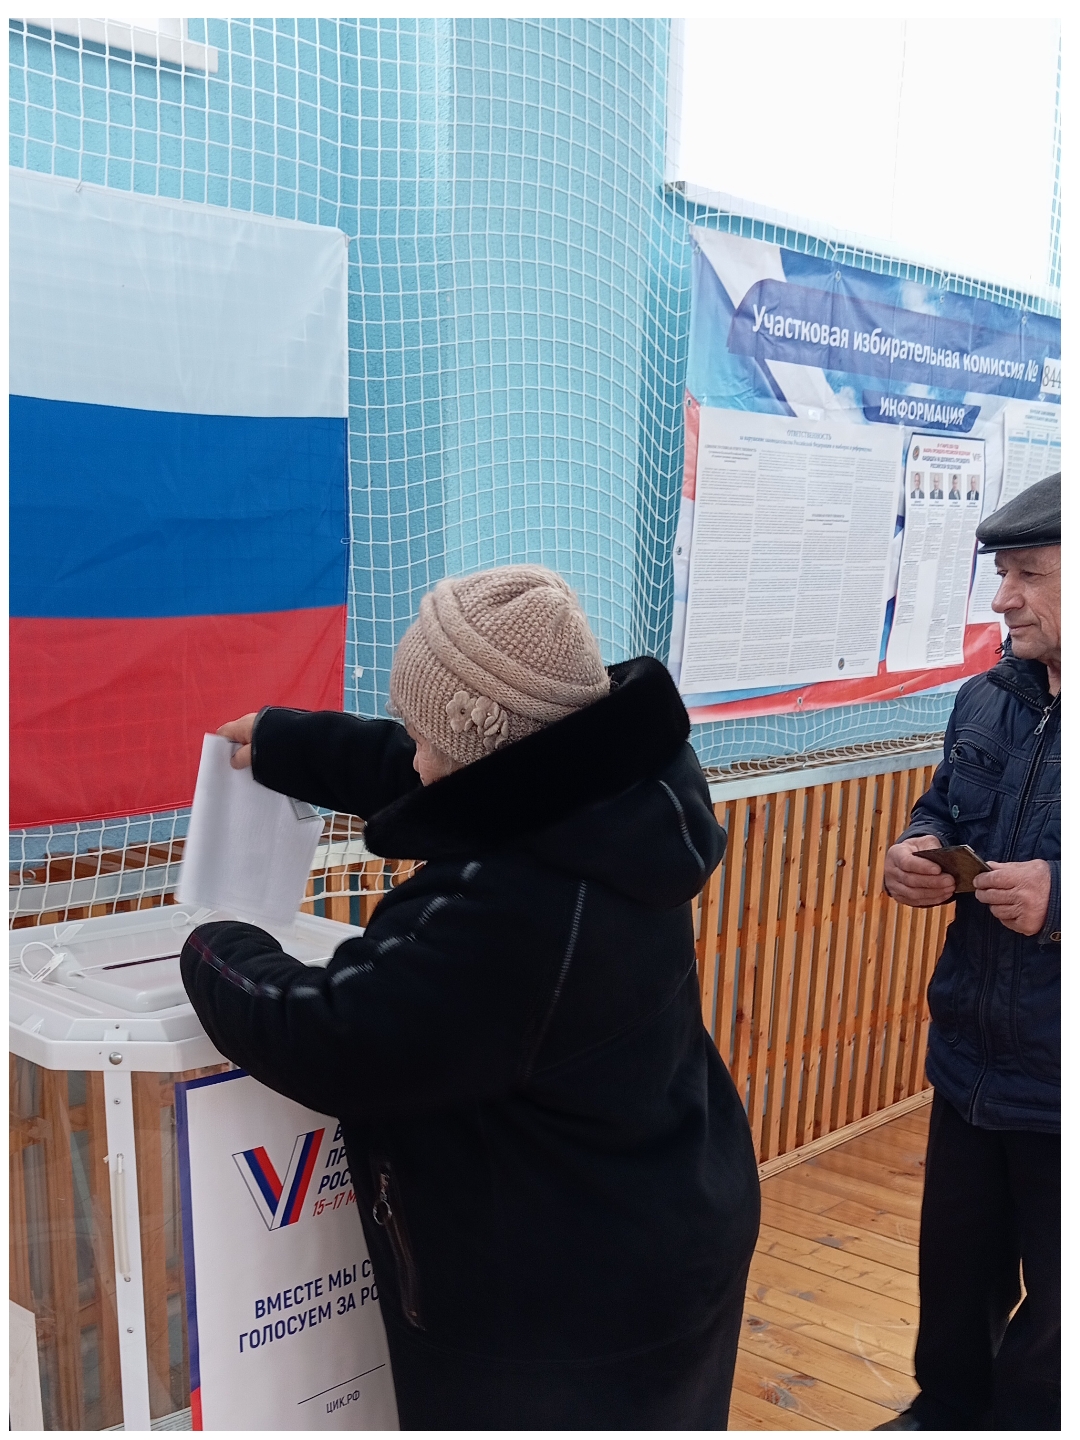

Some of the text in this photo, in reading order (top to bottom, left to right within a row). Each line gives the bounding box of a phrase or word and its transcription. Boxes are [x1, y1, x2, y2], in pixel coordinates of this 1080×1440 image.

[752, 304, 849, 349] Участковая
[853, 328, 961, 370] избирательная
[963, 353, 1025, 380] комиссия
[1025, 360, 1039, 382] №
[879, 397, 965, 428] ИНФОРМАЦИЯ
[318, 1167, 352, 1194] РОС
[255, 1277, 323, 1319] ВМЕСТЕ
[328, 1264, 357, 1291] МЫ
[239, 1301, 332, 1353] ГОЛОСУЕМ
[337, 1293, 356, 1315] ЗА
[326, 1390, 360, 1413] ЦИК.РФ
